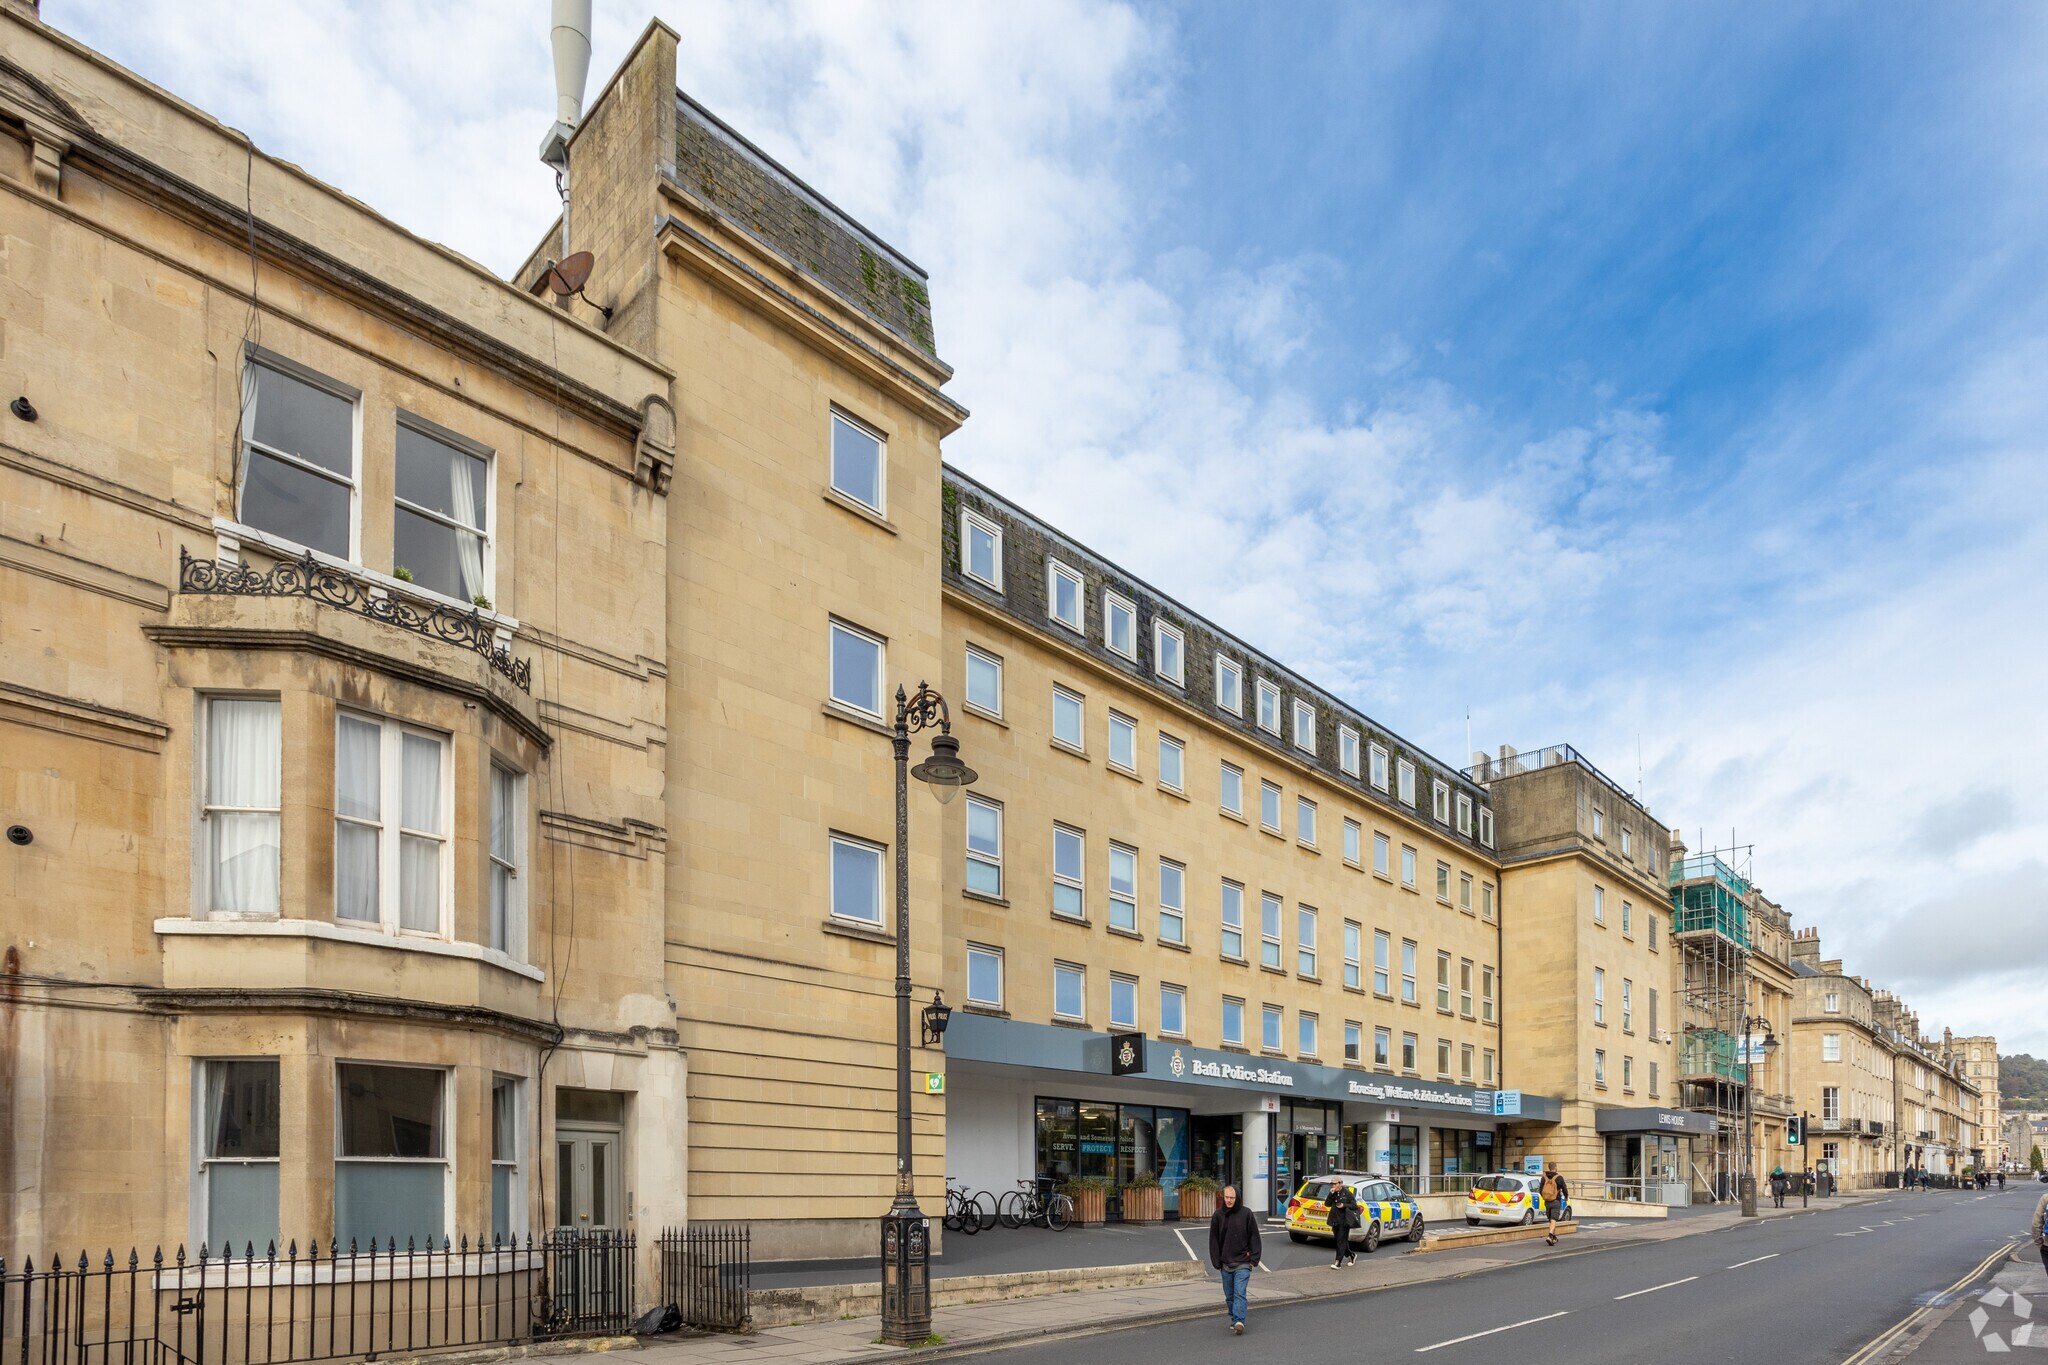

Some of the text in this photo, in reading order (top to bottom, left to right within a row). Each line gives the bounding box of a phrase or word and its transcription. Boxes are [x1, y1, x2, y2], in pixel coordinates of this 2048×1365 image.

[1192, 1060, 1293, 1086] Bath Police Station
[1348, 1081, 1386, 1100] Housing,
[1384, 1085, 1413, 1099] Welfare
[1413, 1089, 1421, 1100] &
[1421, 1089, 1444, 1103] Advice
[1444, 1093, 1472, 1106] Services
[1659, 1113, 1684, 1126] LEWIS HOUSE
[1091, 1134, 1116, 1142] Somerset
[1053, 1143, 1075, 1151] SERVE.
[1292, 1223, 1332, 1231] POLIC
[1384, 1219, 1410, 1231] POLICE
